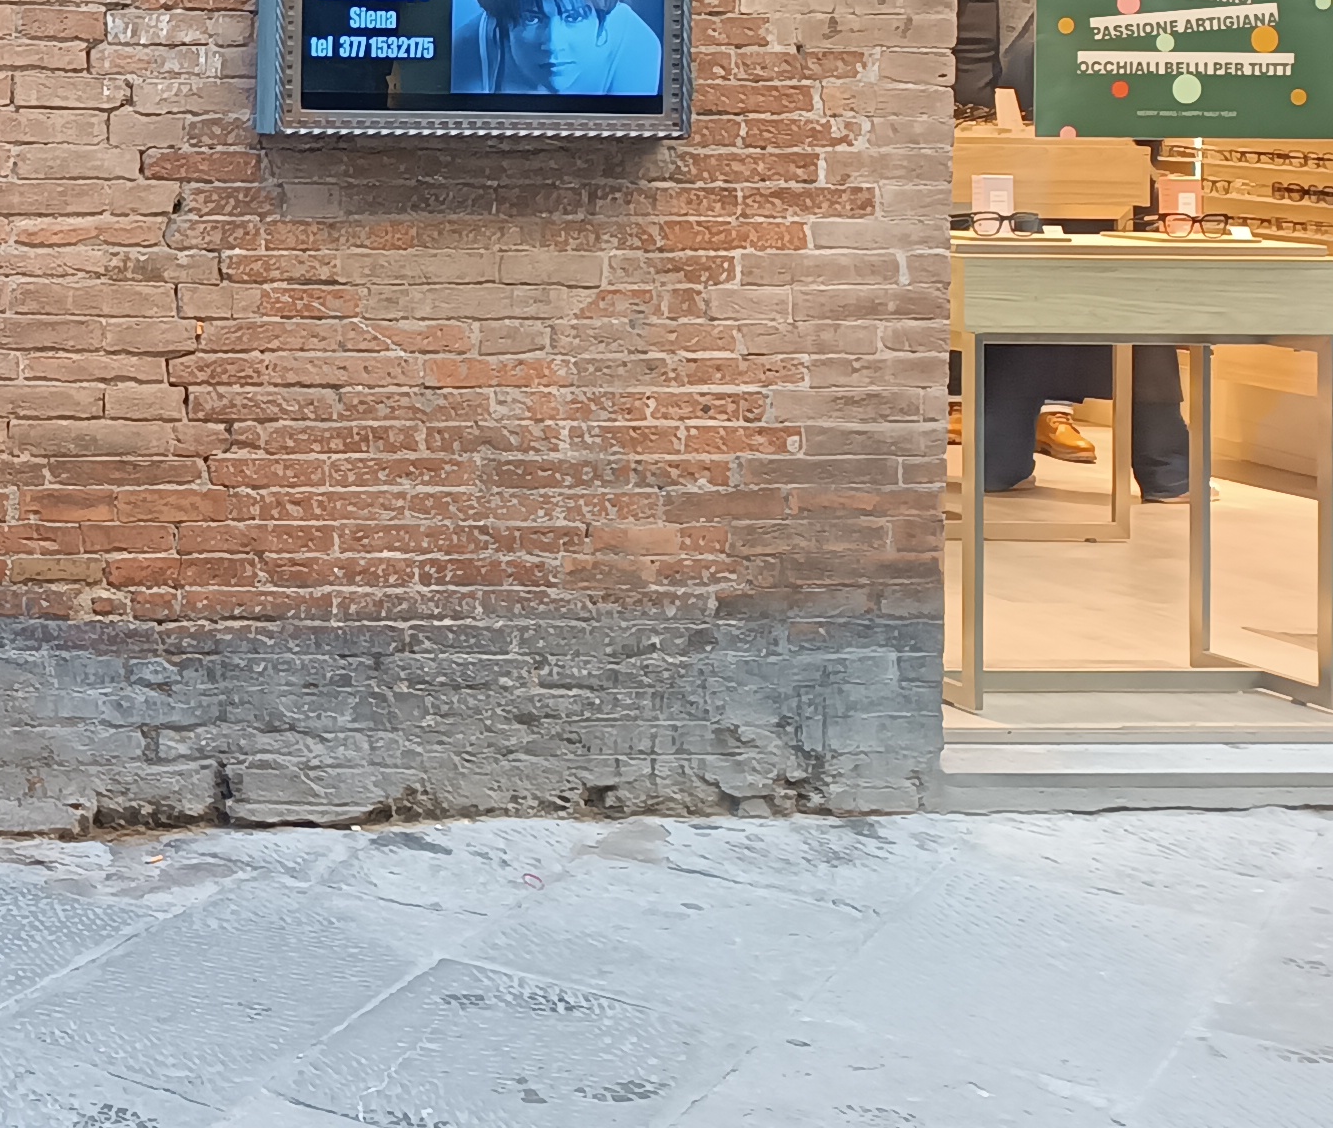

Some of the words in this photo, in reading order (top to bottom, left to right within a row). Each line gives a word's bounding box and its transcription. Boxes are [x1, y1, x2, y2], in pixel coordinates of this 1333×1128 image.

[349, 6, 397, 28] Siena
[1093, 19, 1179, 40] PASSIONE
[1183, 12, 1279, 33] ARTIGIANA
[310, 35, 334, 57] tel
[339, 35, 367, 58] 377
[369, 36, 434, 59] 1532175
[1077, 60, 1161, 74] OCCHIALI
[1164, 61, 1209, 74] BELLI
[1213, 62, 1245, 74] PER
